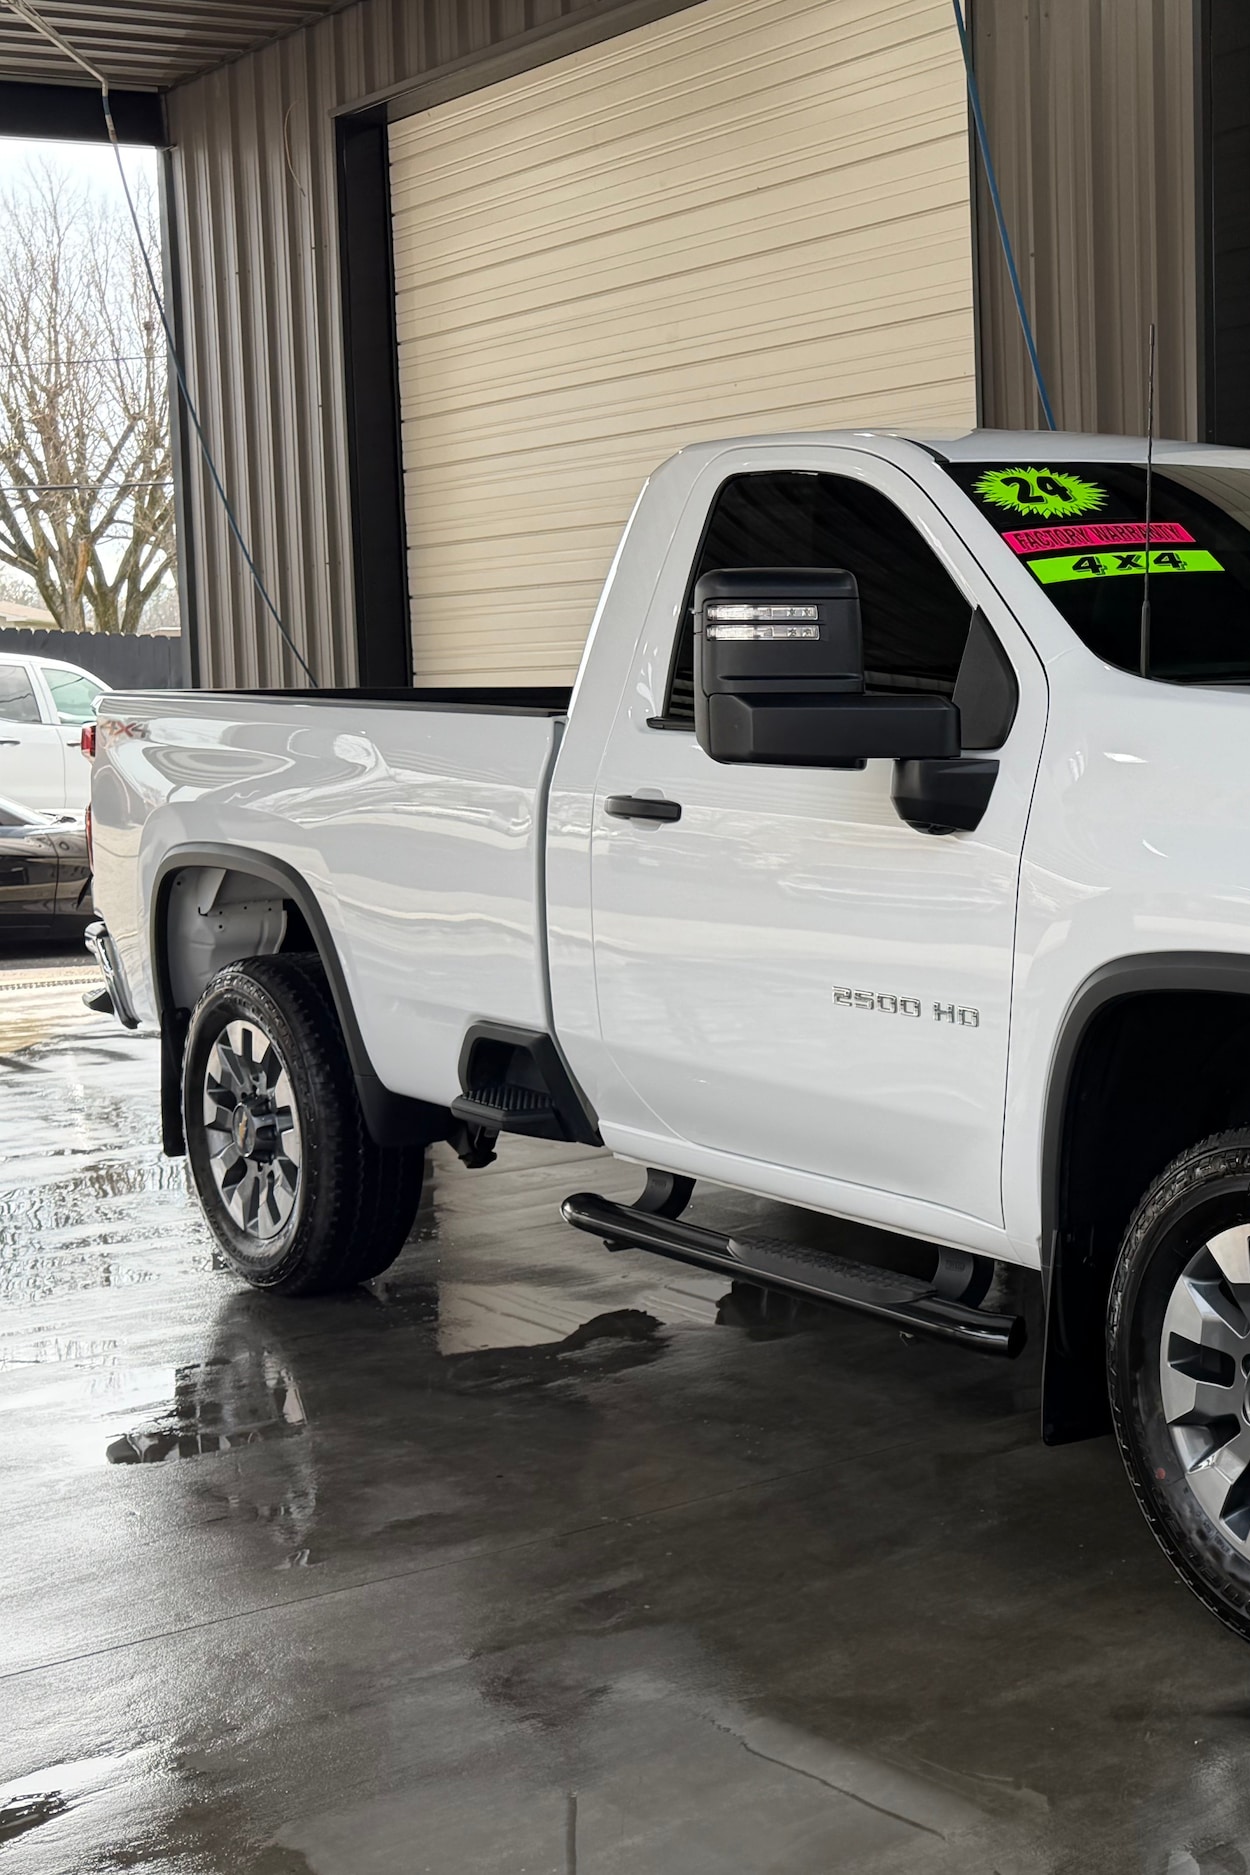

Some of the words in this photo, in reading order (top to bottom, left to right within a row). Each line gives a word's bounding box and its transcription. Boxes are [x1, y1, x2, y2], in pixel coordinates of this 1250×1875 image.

[1000, 476, 1076, 504] 24
[1013, 527, 1093, 551] FACTORY
[1089, 523, 1182, 543] WARRANTY
[832, 985, 922, 1018] 2500
[933, 1001, 980, 1028] HD
